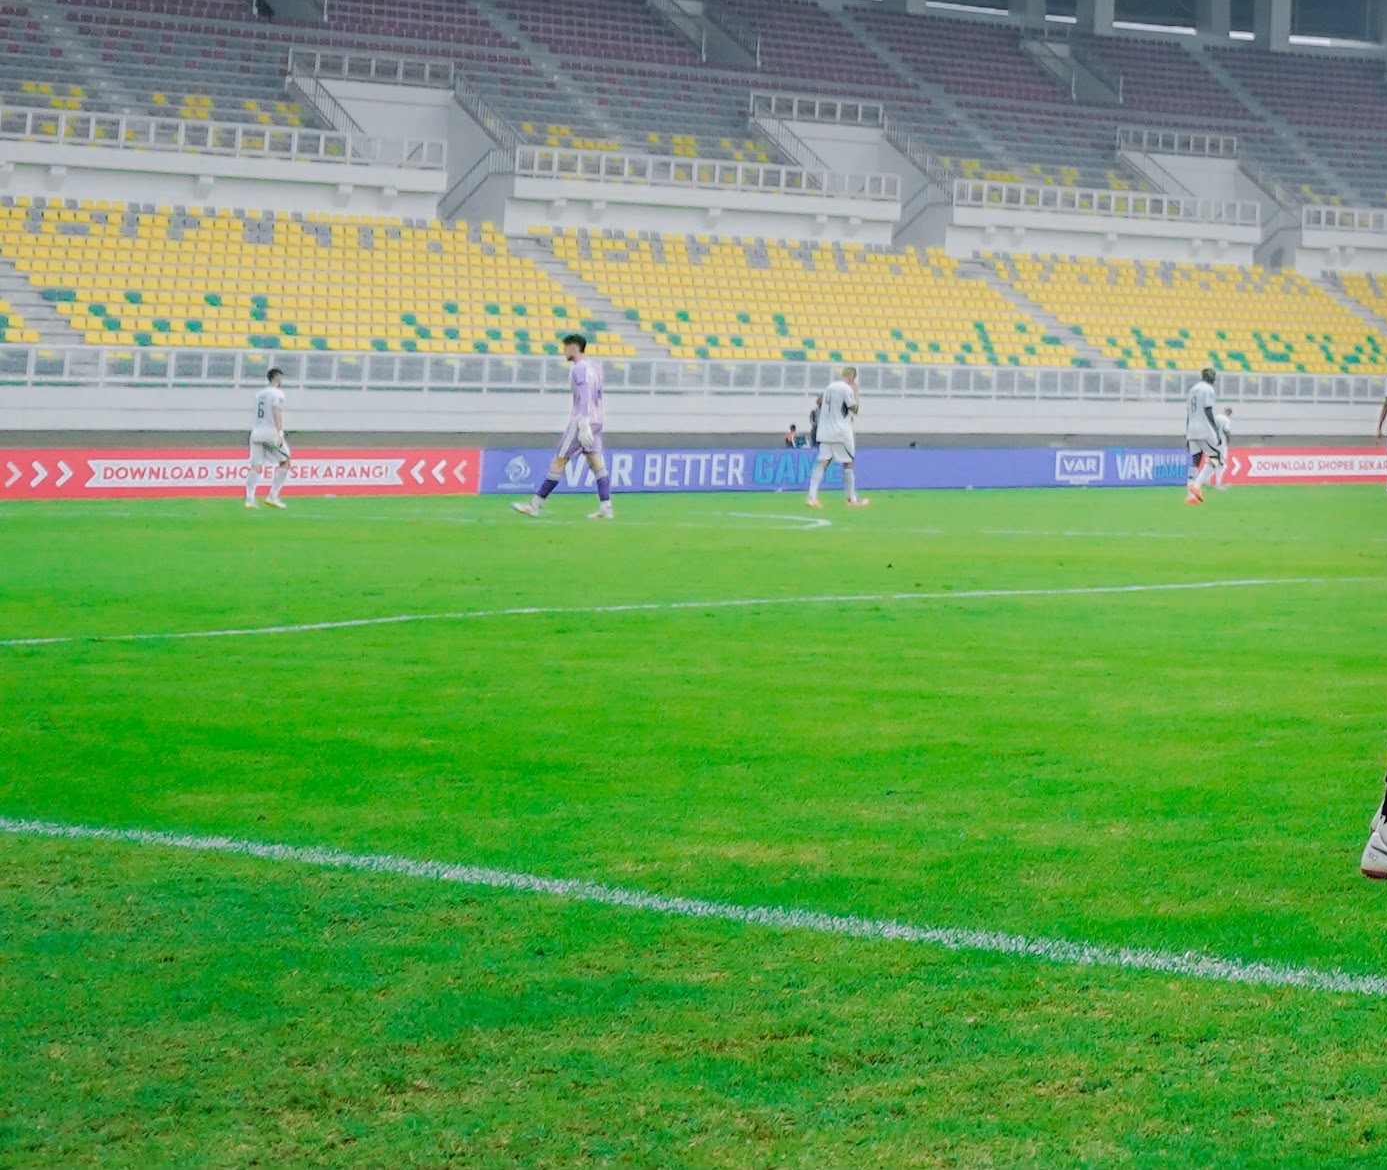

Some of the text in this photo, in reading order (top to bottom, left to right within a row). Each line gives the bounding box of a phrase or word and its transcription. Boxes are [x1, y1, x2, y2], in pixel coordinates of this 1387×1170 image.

[257, 401, 265, 418] 6
[103, 465, 209, 480] DOWNLOAD
[289, 464, 390, 480] SEKARANG!
[643, 453, 745, 487] BETTER
[1063, 458, 1098, 472] VAR
[1115, 453, 1153, 480] VAR
